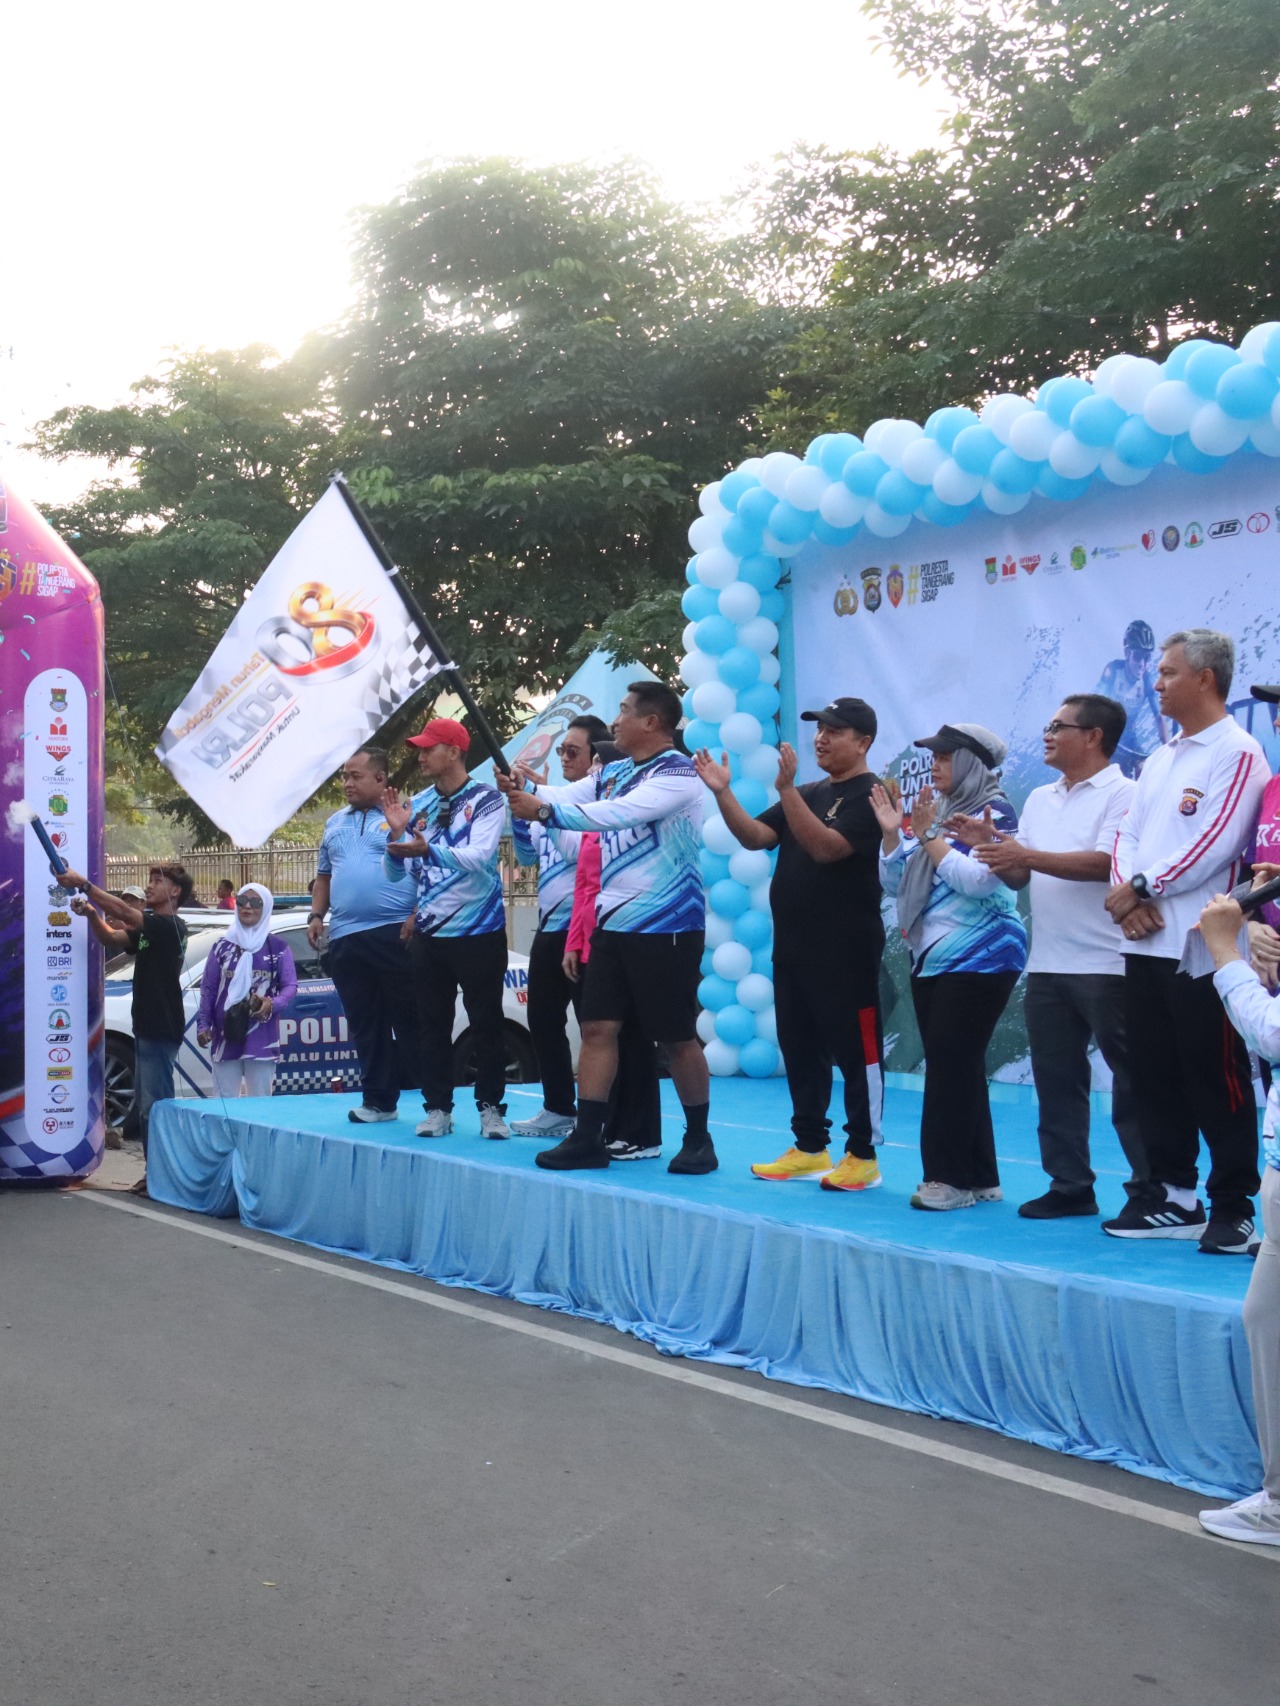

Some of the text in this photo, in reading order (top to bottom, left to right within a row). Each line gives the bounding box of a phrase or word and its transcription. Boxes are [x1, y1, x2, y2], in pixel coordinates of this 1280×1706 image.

[921, 560, 949, 576] POLRESTA
[921, 572, 955, 589] TANGERANG
[36, 585, 59, 597] SIGAP
[921, 588, 939, 603] SIGAP
[901, 751, 935, 777] POLR
[46, 928, 72, 938] intens
[58, 957, 72, 966] BRI
[279, 1015, 349, 1046] POLI
